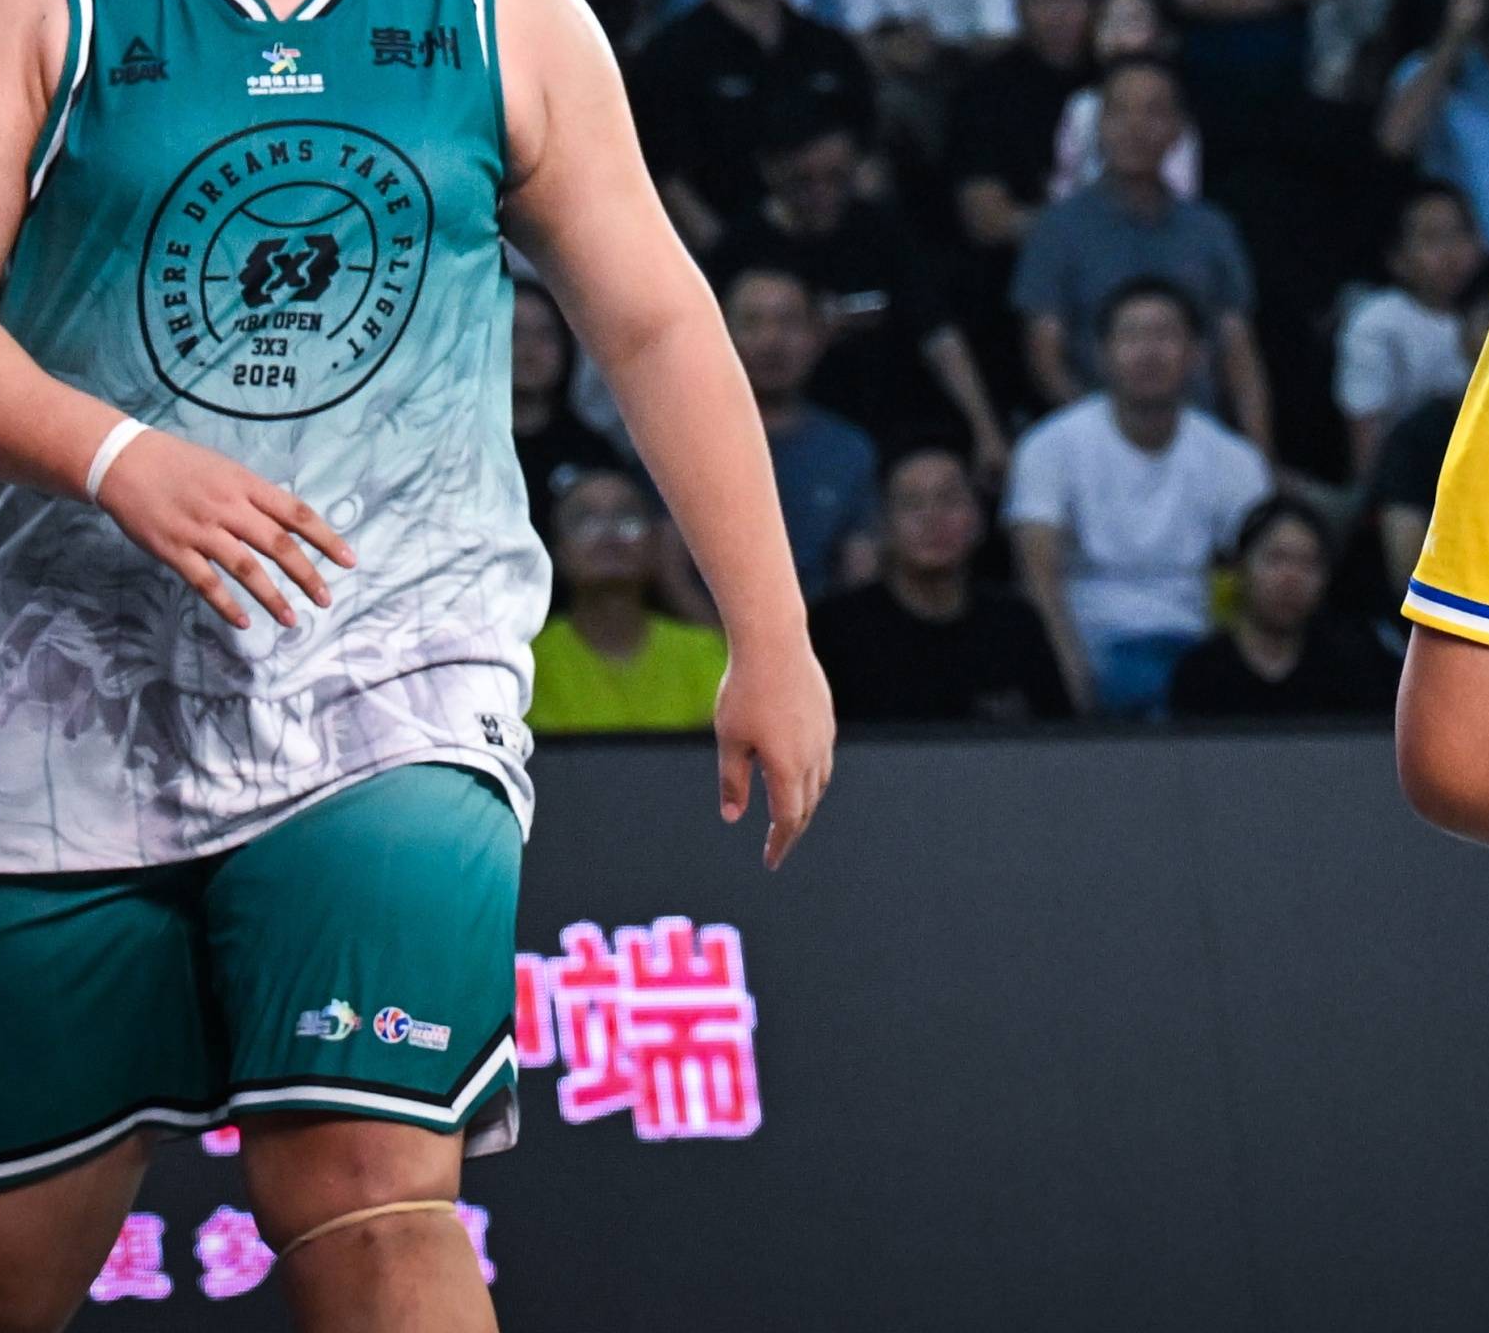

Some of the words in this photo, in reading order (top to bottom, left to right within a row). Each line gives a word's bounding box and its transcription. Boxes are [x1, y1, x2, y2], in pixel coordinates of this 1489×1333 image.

[370, 26, 462, 70] 贵州
[182, 139, 314, 224] DREAMS
[339, 144, 412, 215] TAKE
[163, 240, 201, 358] WHERE
[272, 312, 323, 333] OPEN
[347, 235, 413, 360] FLIGHT
[250, 337, 288, 356] 3X3
[233, 363, 297, 388] 2024
